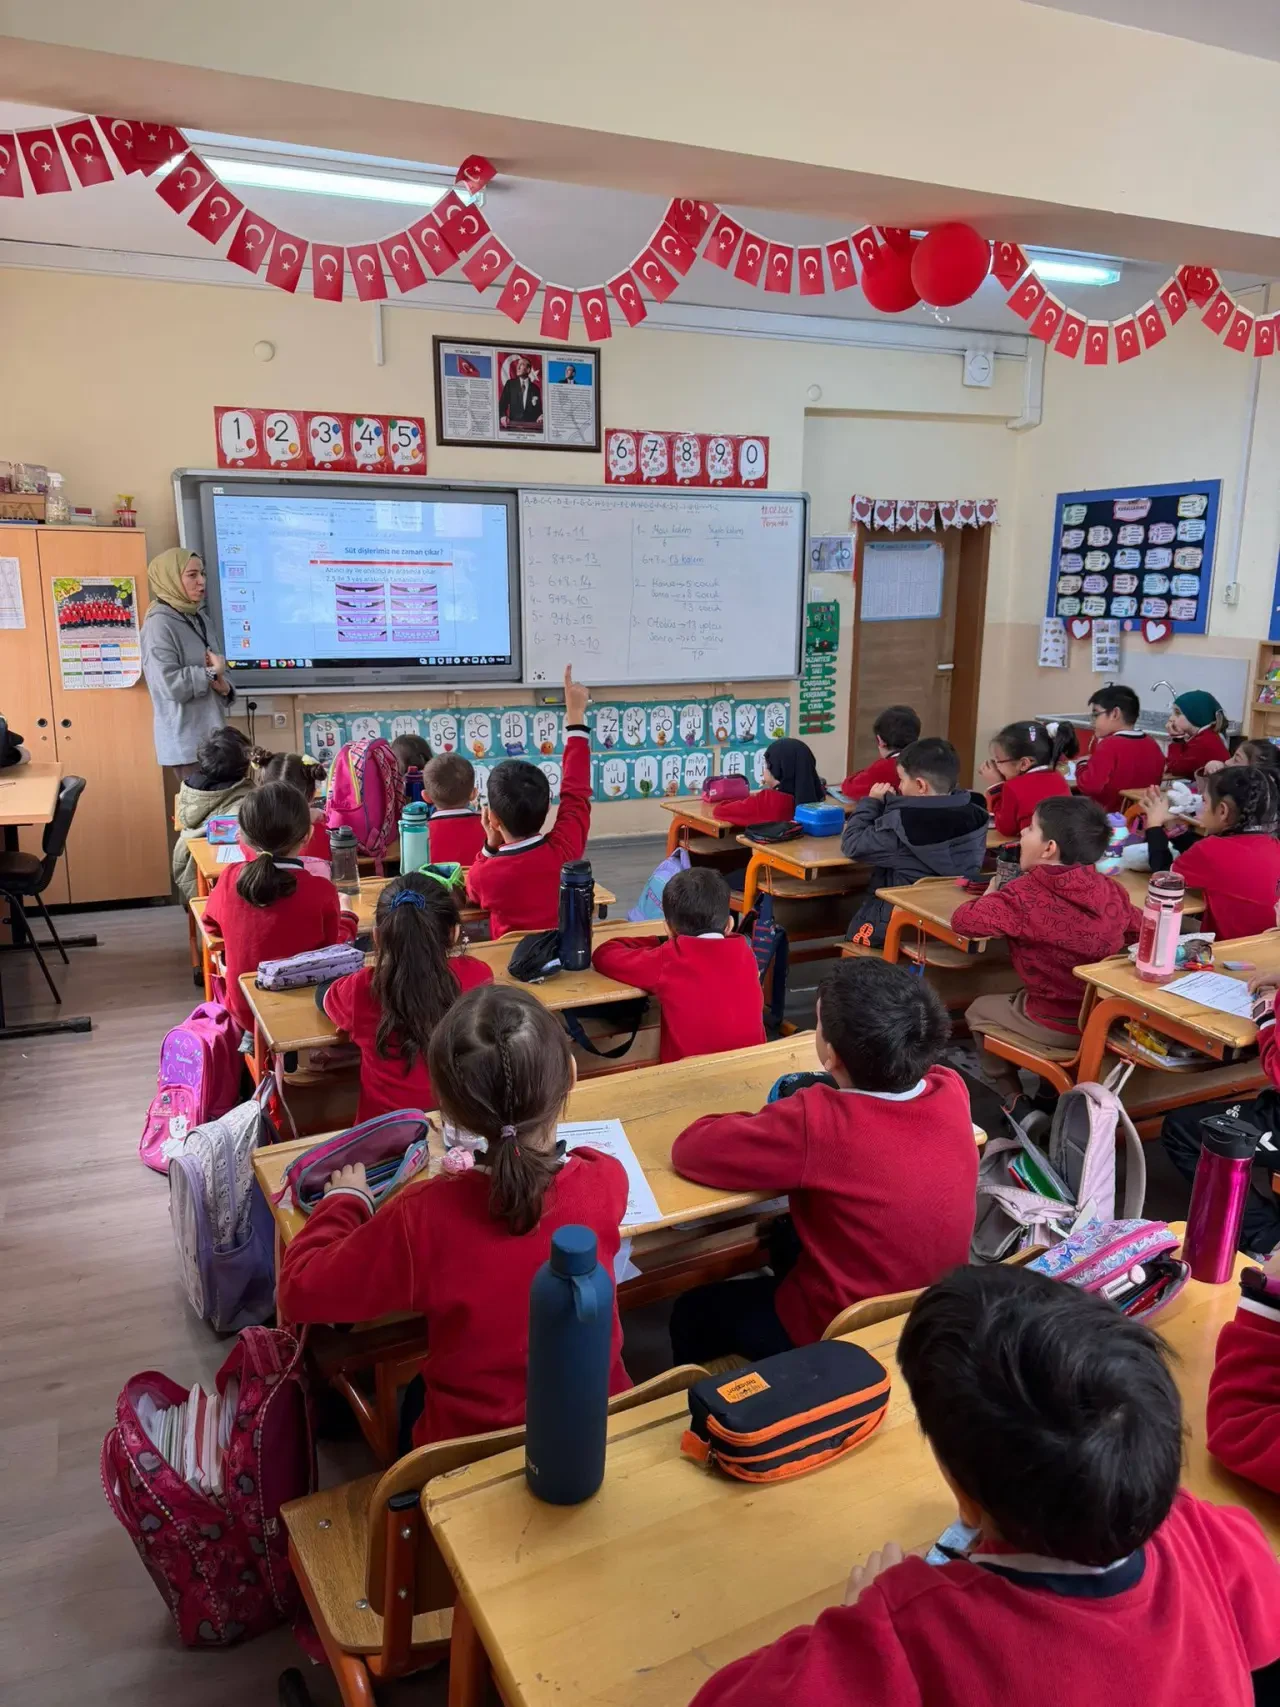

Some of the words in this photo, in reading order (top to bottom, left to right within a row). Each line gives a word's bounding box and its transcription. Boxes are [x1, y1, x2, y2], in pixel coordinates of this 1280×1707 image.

[233, 417, 241, 440] 1
[274, 420, 289, 442] 2
[318, 422, 332, 444] 3
[360, 424, 375, 446] 4
[398, 426, 412, 447] 5
[616, 439, 627, 459] 6
[648, 440, 659, 460] 7
[682, 441, 692, 462] 8
[715, 443, 726, 463] 9
[746, 444, 758, 464] 0
[345, 546, 357, 554] Süt
[358, 547, 390, 556] dişlerimiz
[315, 732, 336, 748] bB
[434, 727, 457, 747] gG
[469, 724, 489, 739] cC
[504, 724, 523, 738] dD
[685, 765, 706, 777] mM
